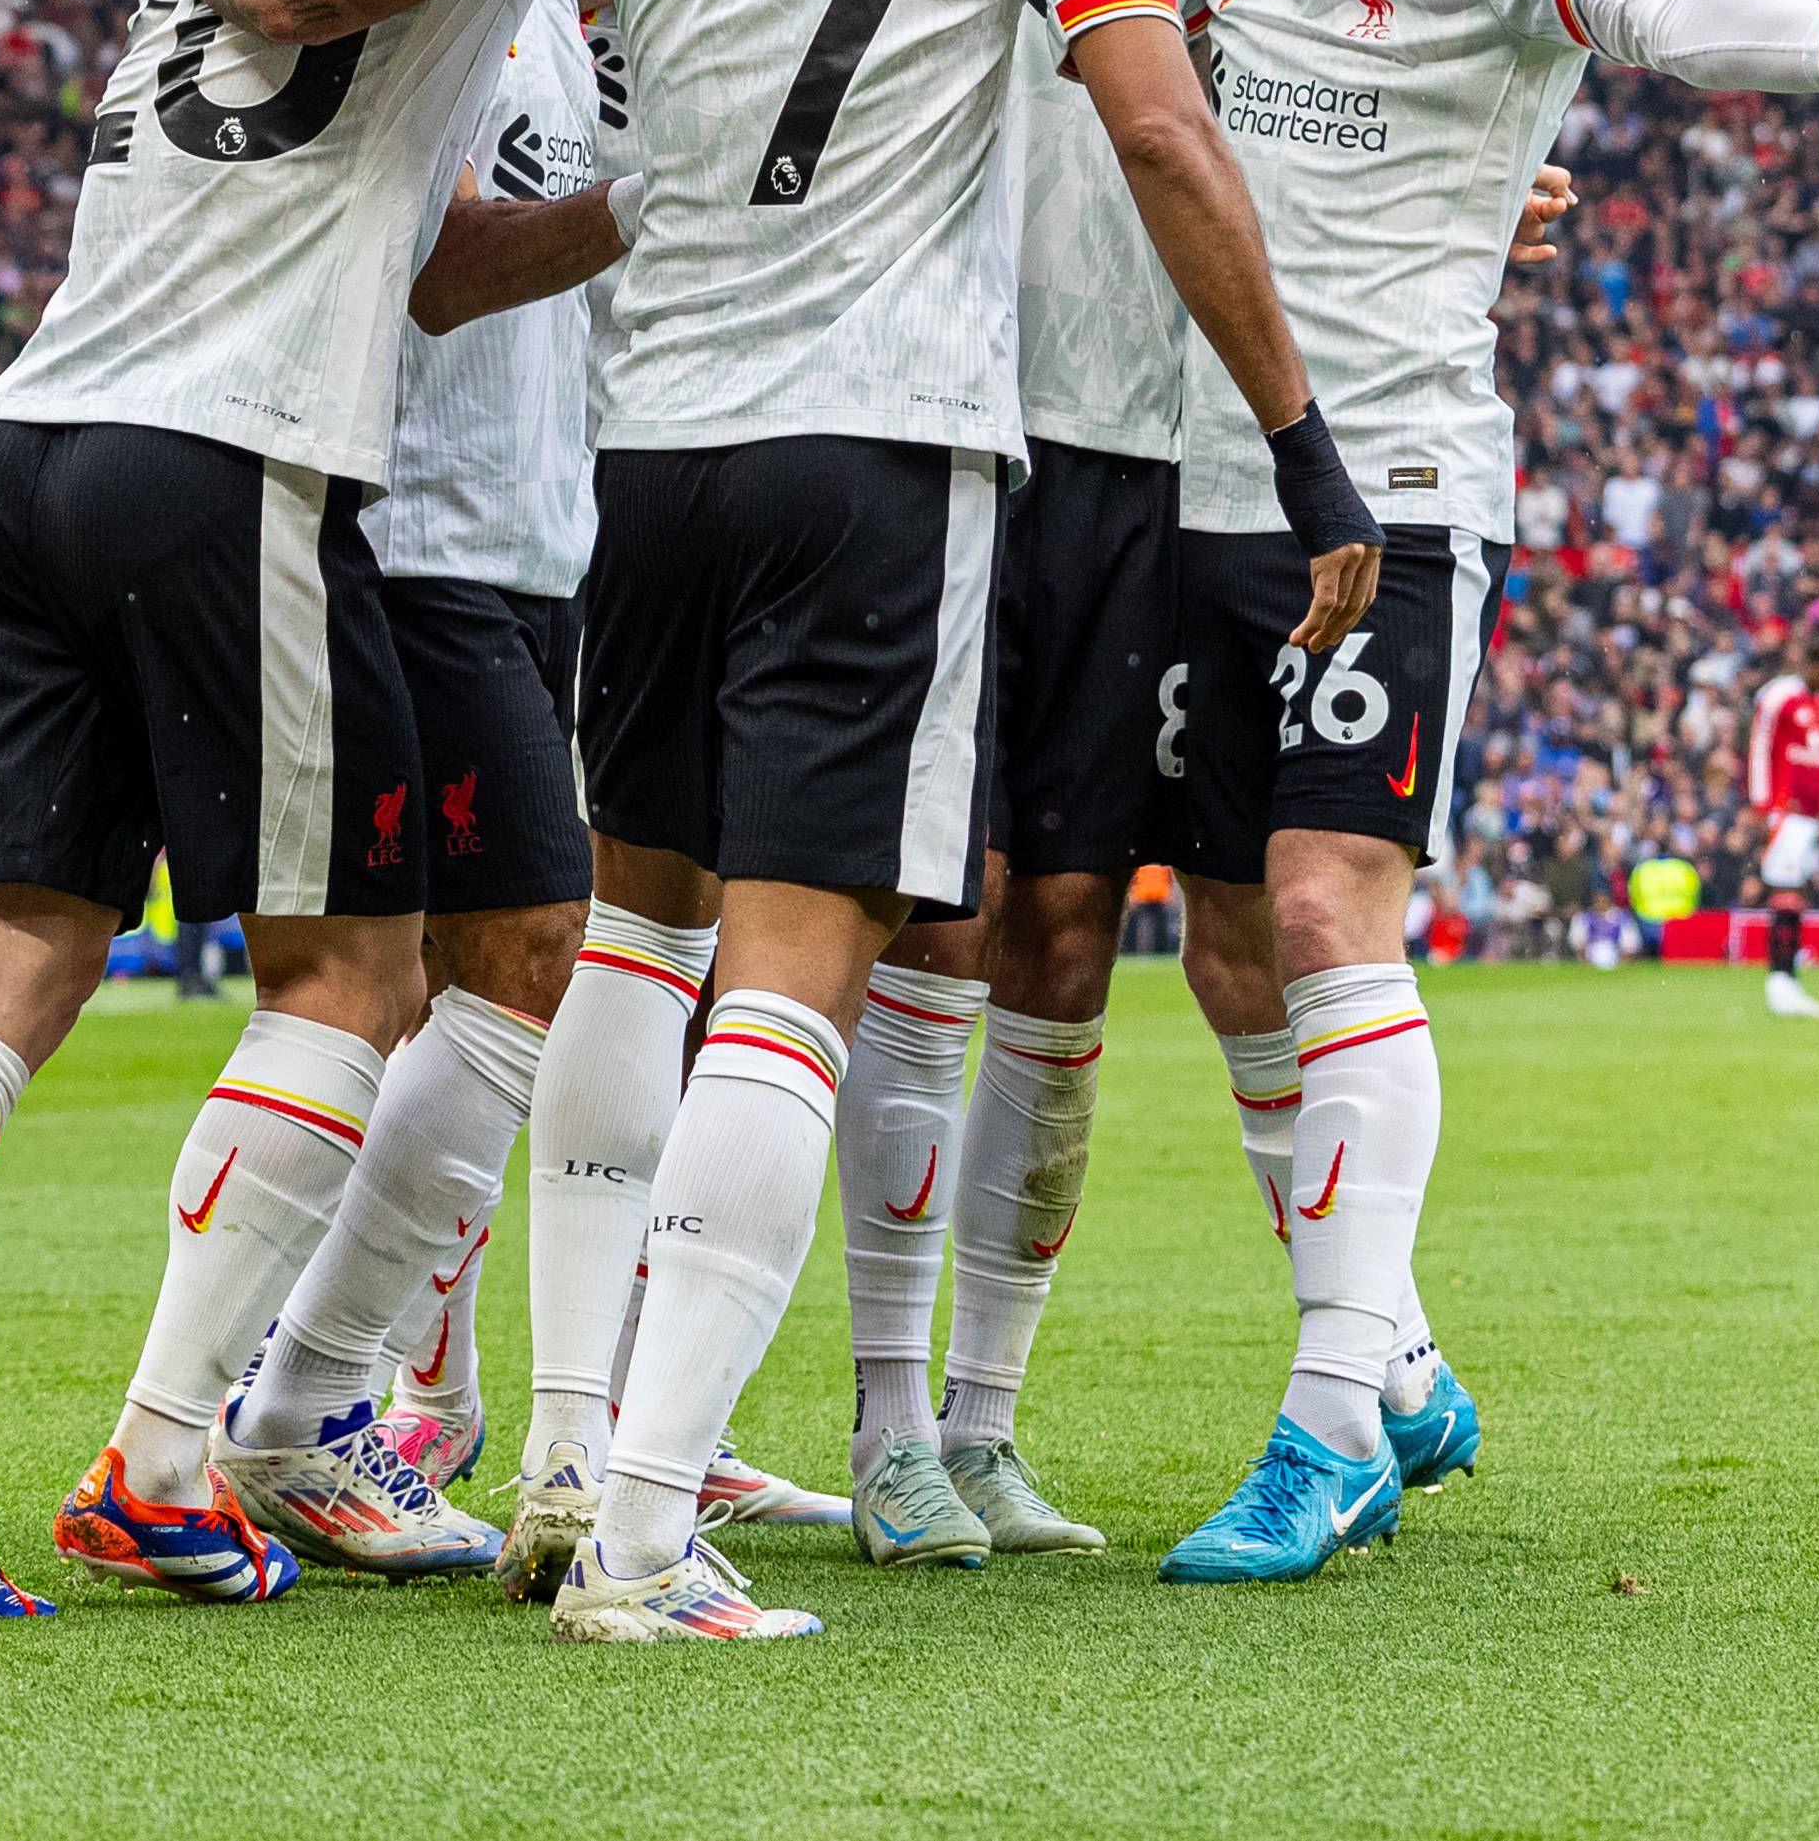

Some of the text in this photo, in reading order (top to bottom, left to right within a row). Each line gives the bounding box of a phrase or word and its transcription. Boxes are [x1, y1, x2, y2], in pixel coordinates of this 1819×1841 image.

[1233, 70, 1380, 118] standard
[1228, 103, 1388, 152] chartered
[1269, 632, 1389, 752] 26
[564, 1160, 627, 1183] LFC
[653, 1216, 703, 1234] LFC
